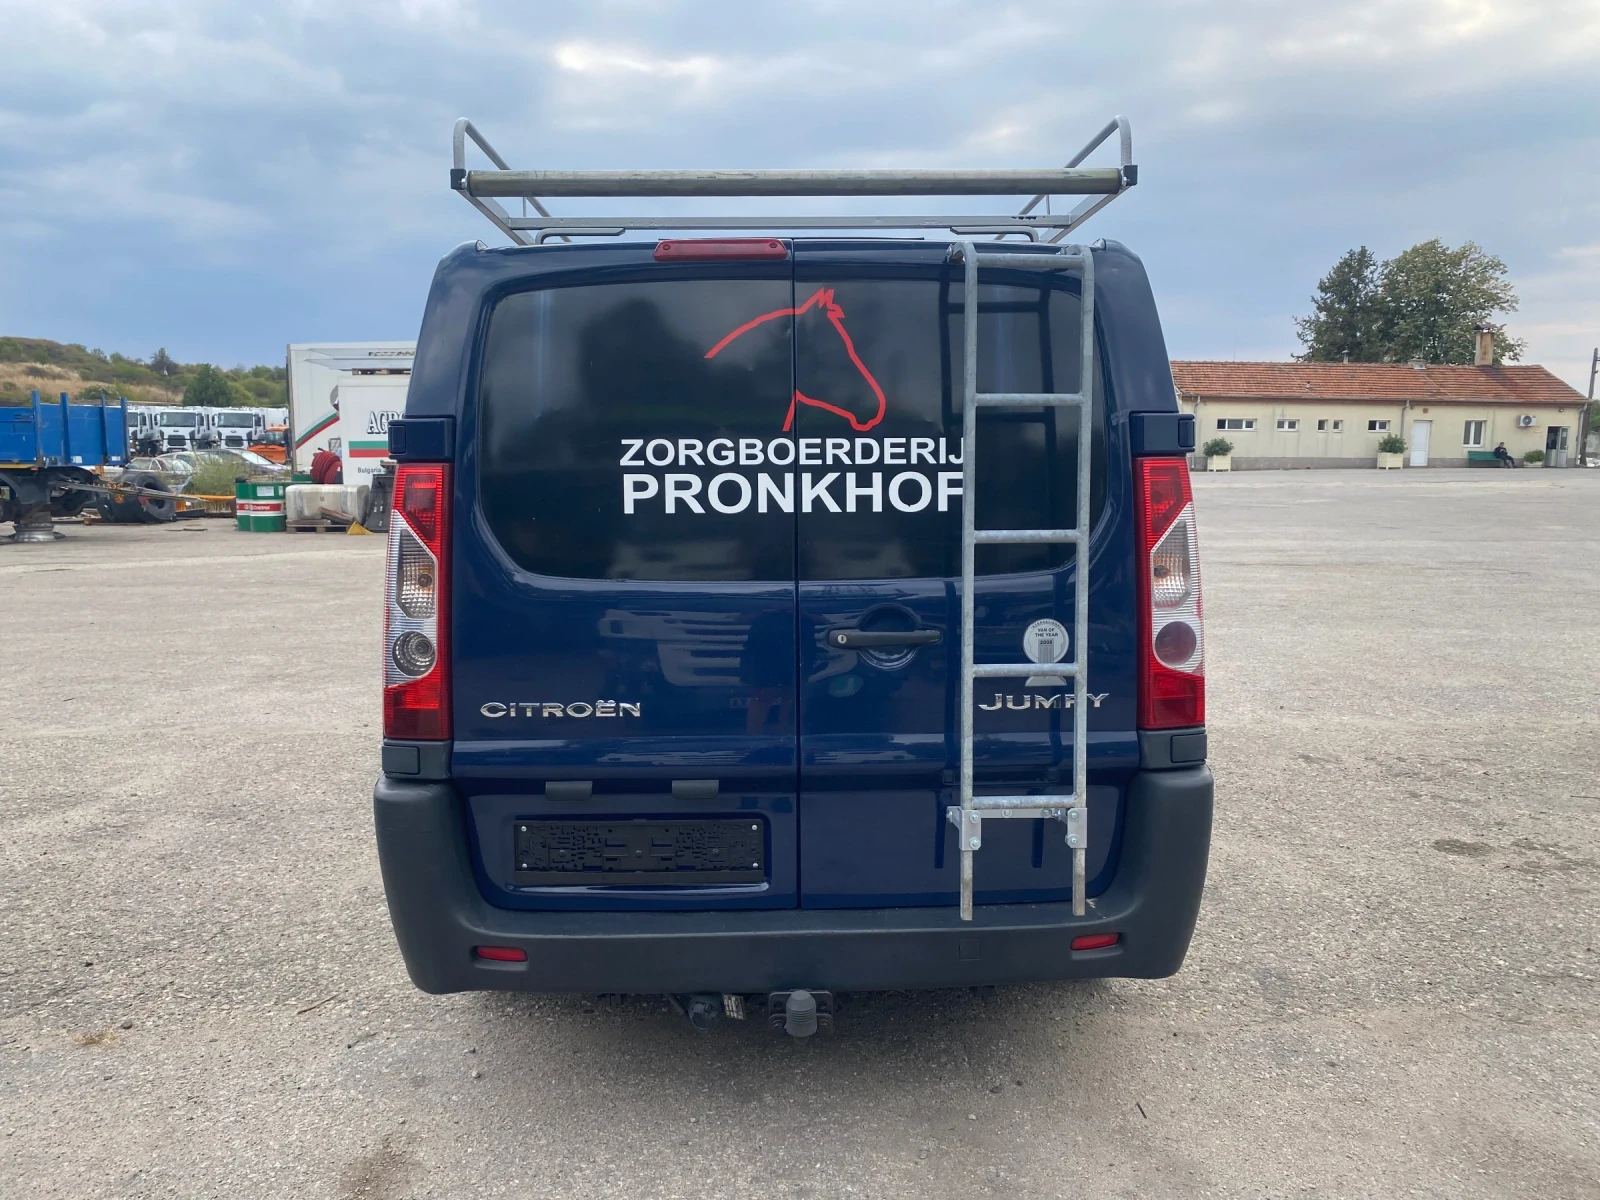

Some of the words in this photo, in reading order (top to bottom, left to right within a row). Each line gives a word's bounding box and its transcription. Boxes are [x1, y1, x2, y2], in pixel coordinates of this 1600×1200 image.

[619, 437, 964, 467] ZORGBOERDERIJ
[622, 471, 964, 515] PRONKHOF
[480, 699, 641, 718] CITROËN
